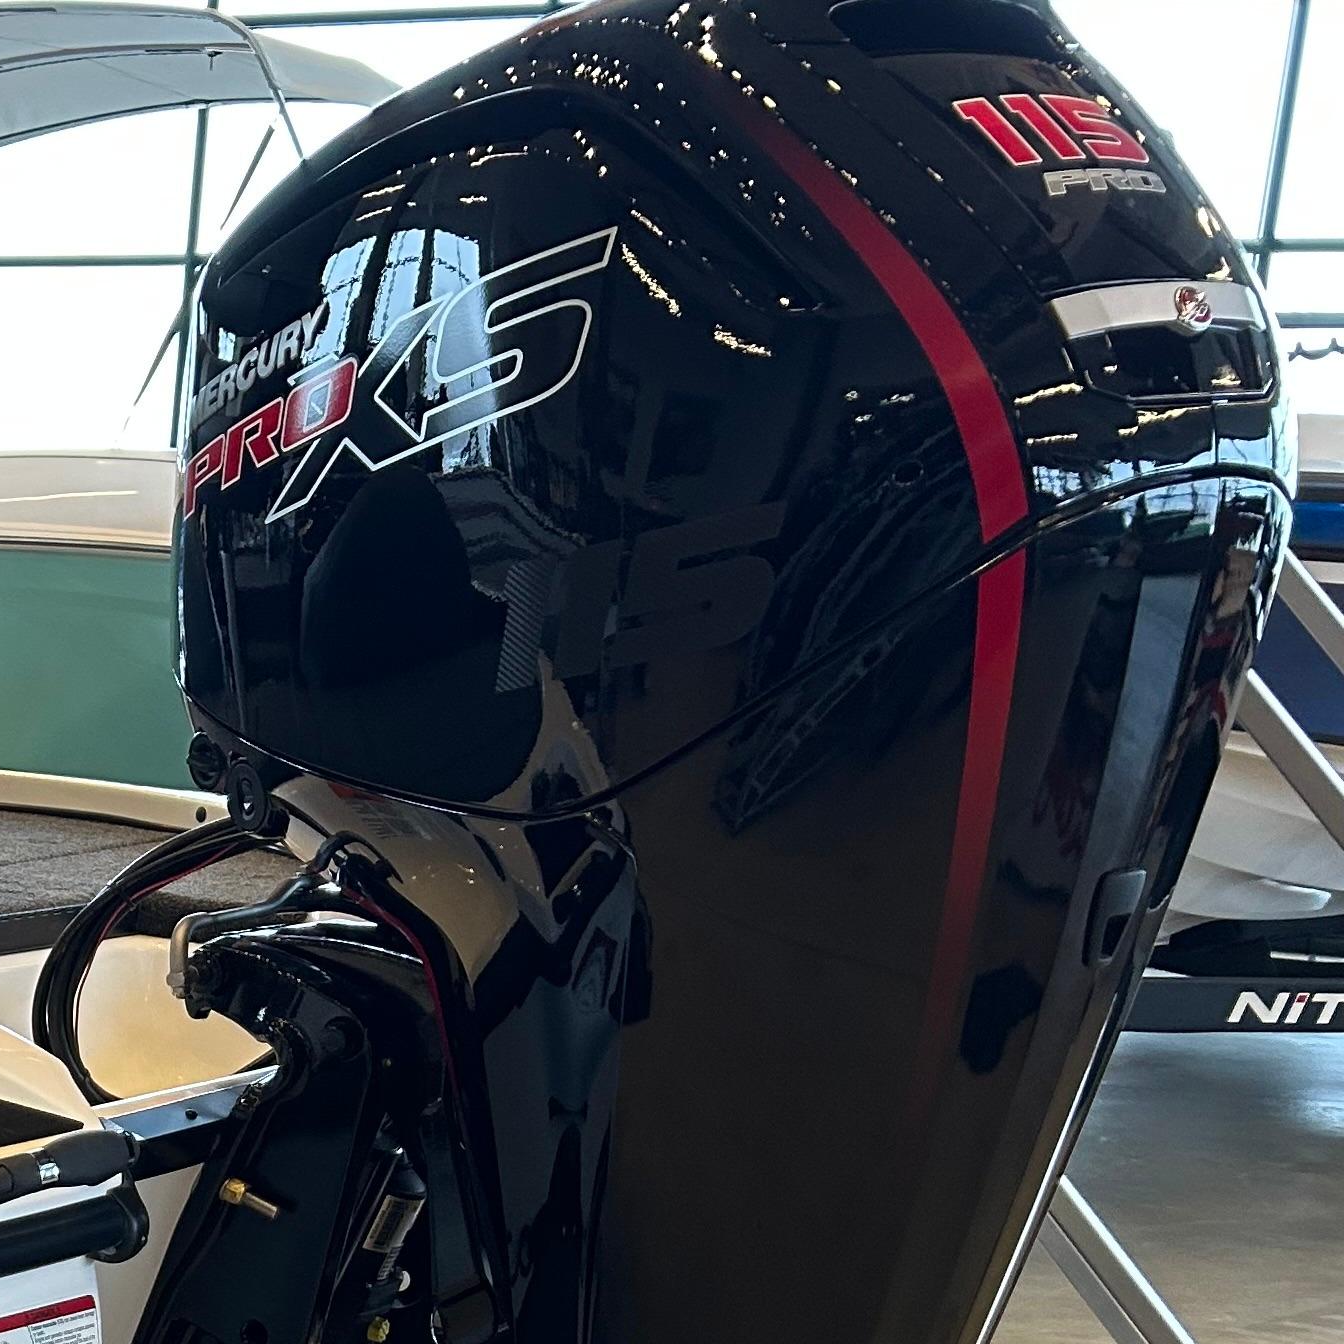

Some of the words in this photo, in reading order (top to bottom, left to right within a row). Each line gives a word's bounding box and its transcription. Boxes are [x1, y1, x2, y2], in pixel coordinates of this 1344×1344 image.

[951, 93, 1150, 167] 115
[1042, 168, 1166, 197] PRO
[264, 226, 618, 525] XS
[183, 353, 358, 522] PRO
